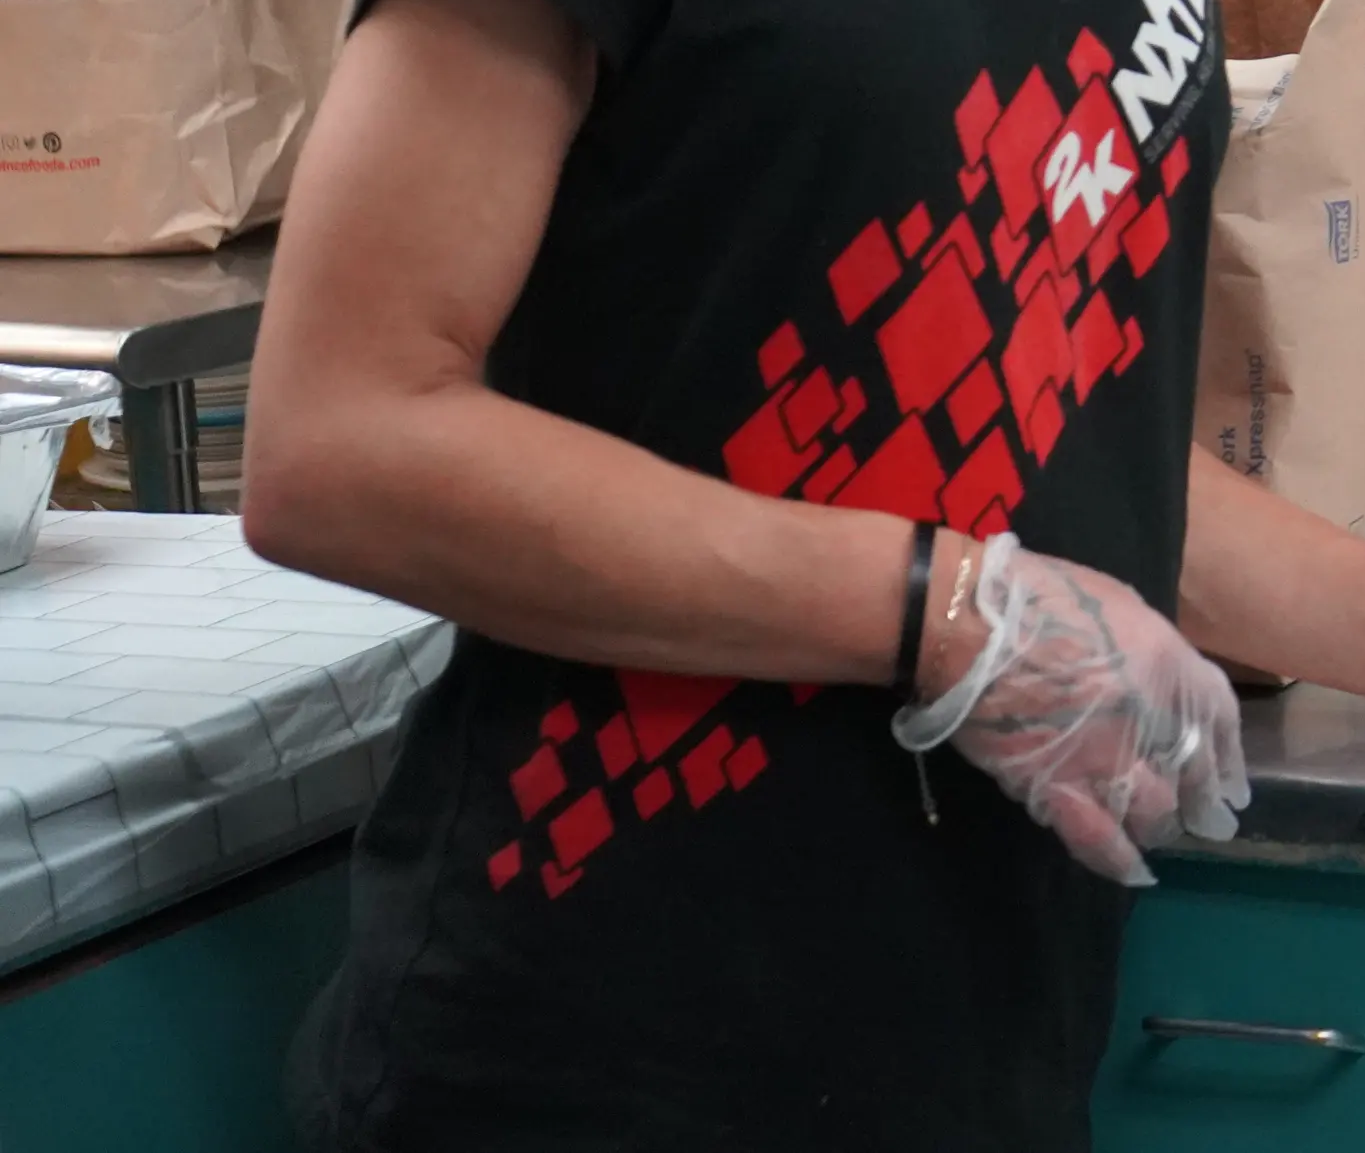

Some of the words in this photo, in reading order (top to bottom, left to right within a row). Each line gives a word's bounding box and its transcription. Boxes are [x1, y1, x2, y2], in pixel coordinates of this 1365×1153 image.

[1043, 128, 1135, 227] 2K
[1335, 203, 1351, 263] TORK
[1218, 426, 1237, 465] ork
